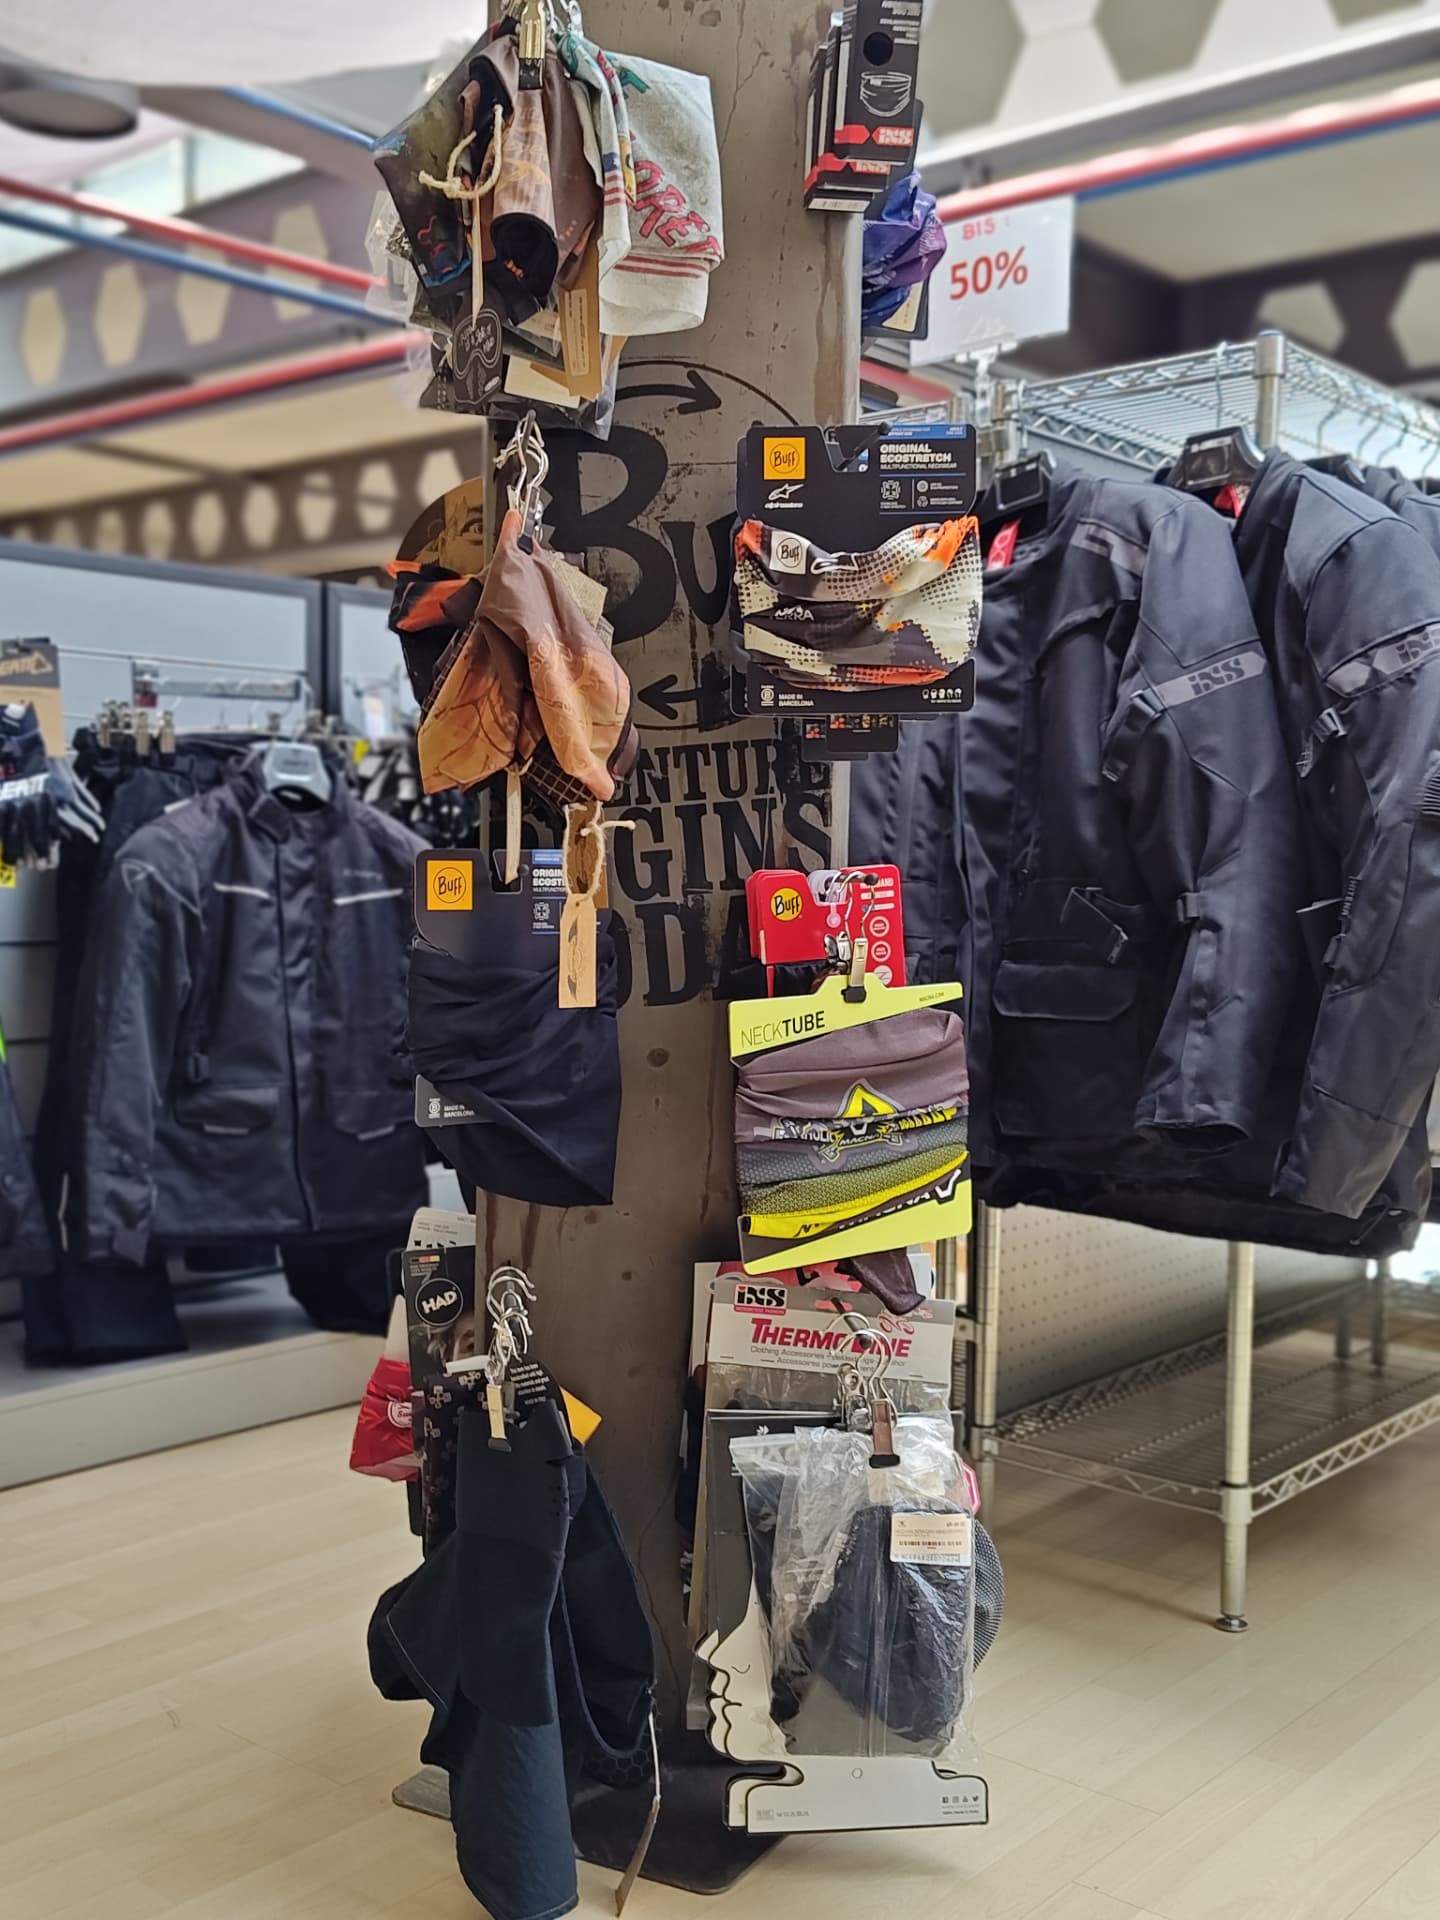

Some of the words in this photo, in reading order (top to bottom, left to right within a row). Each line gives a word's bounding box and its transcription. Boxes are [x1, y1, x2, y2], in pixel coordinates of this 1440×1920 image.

[962, 216, 997, 240] BIS
[949, 245, 1029, 301] 50%
[773, 450, 796, 468] Buff
[880, 443, 932, 454] ORIGINAL
[880, 452, 952, 463] ECOSTRETCH
[780, 544, 800, 563] Buff
[437, 875, 463, 896] Buff
[773, 894, 803, 918] Buff
[421, 1290, 458, 1315] HAD
